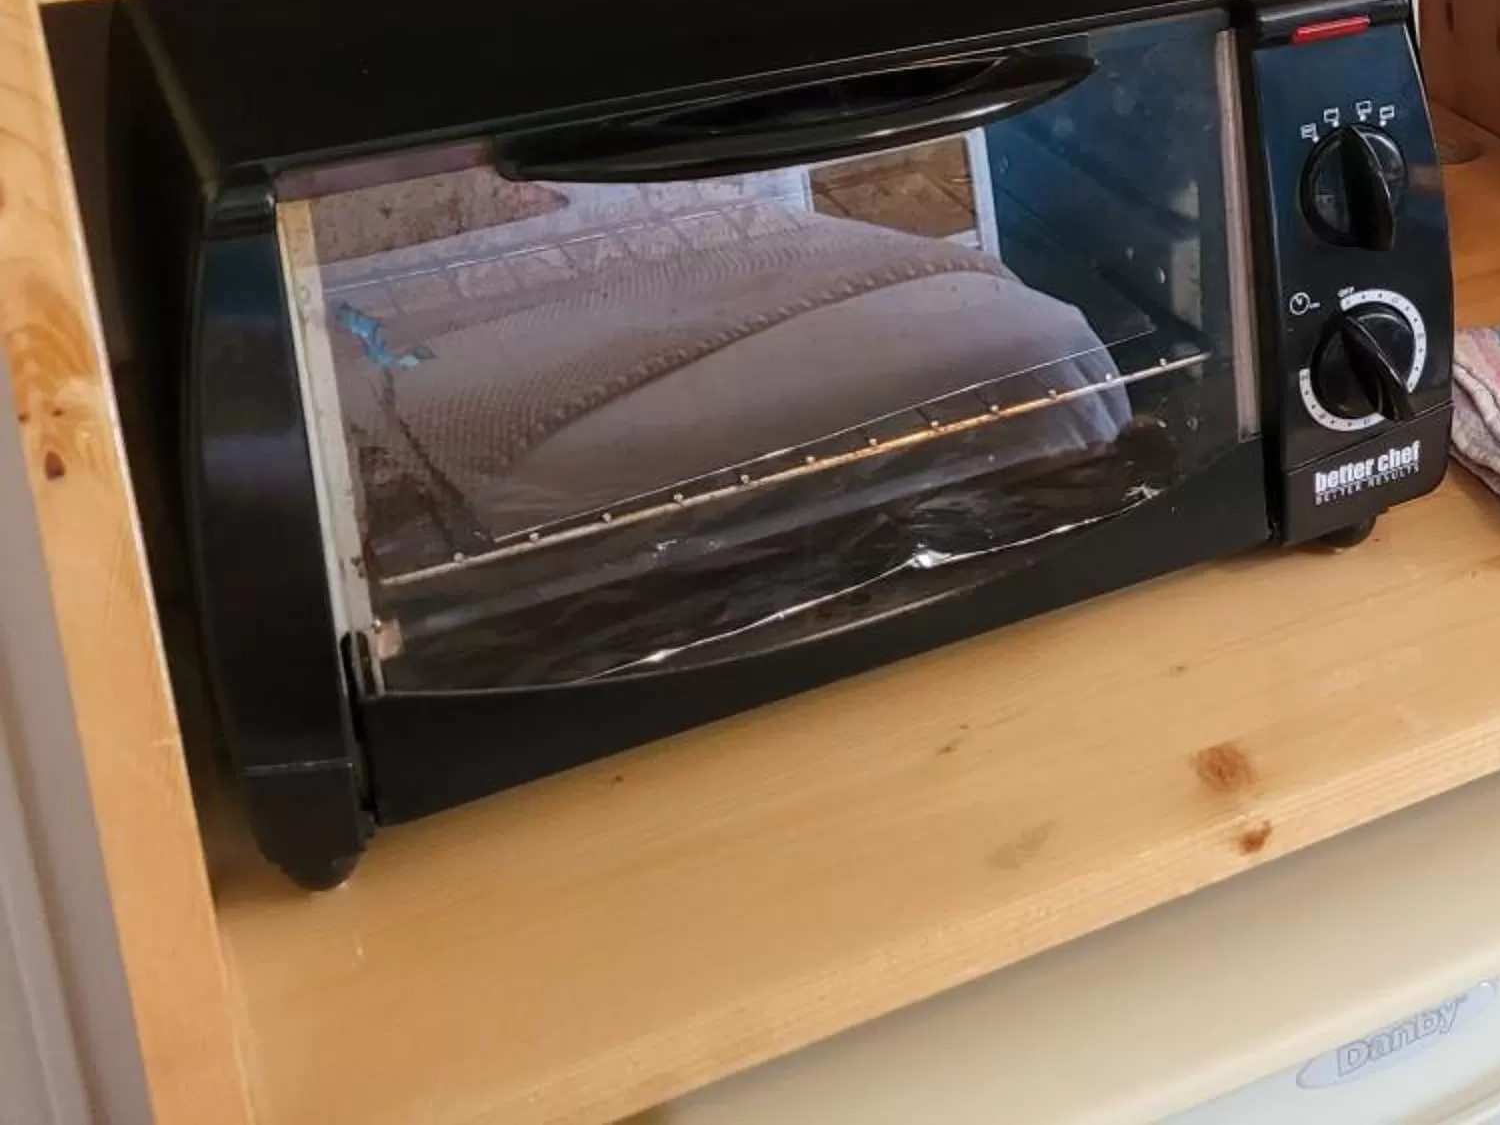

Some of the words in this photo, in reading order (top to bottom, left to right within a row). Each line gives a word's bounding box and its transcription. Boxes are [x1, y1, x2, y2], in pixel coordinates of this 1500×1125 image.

[1315, 455, 1374, 494] better
[1377, 440, 1421, 472] chef
[1336, 992, 1468, 1078] Danby
